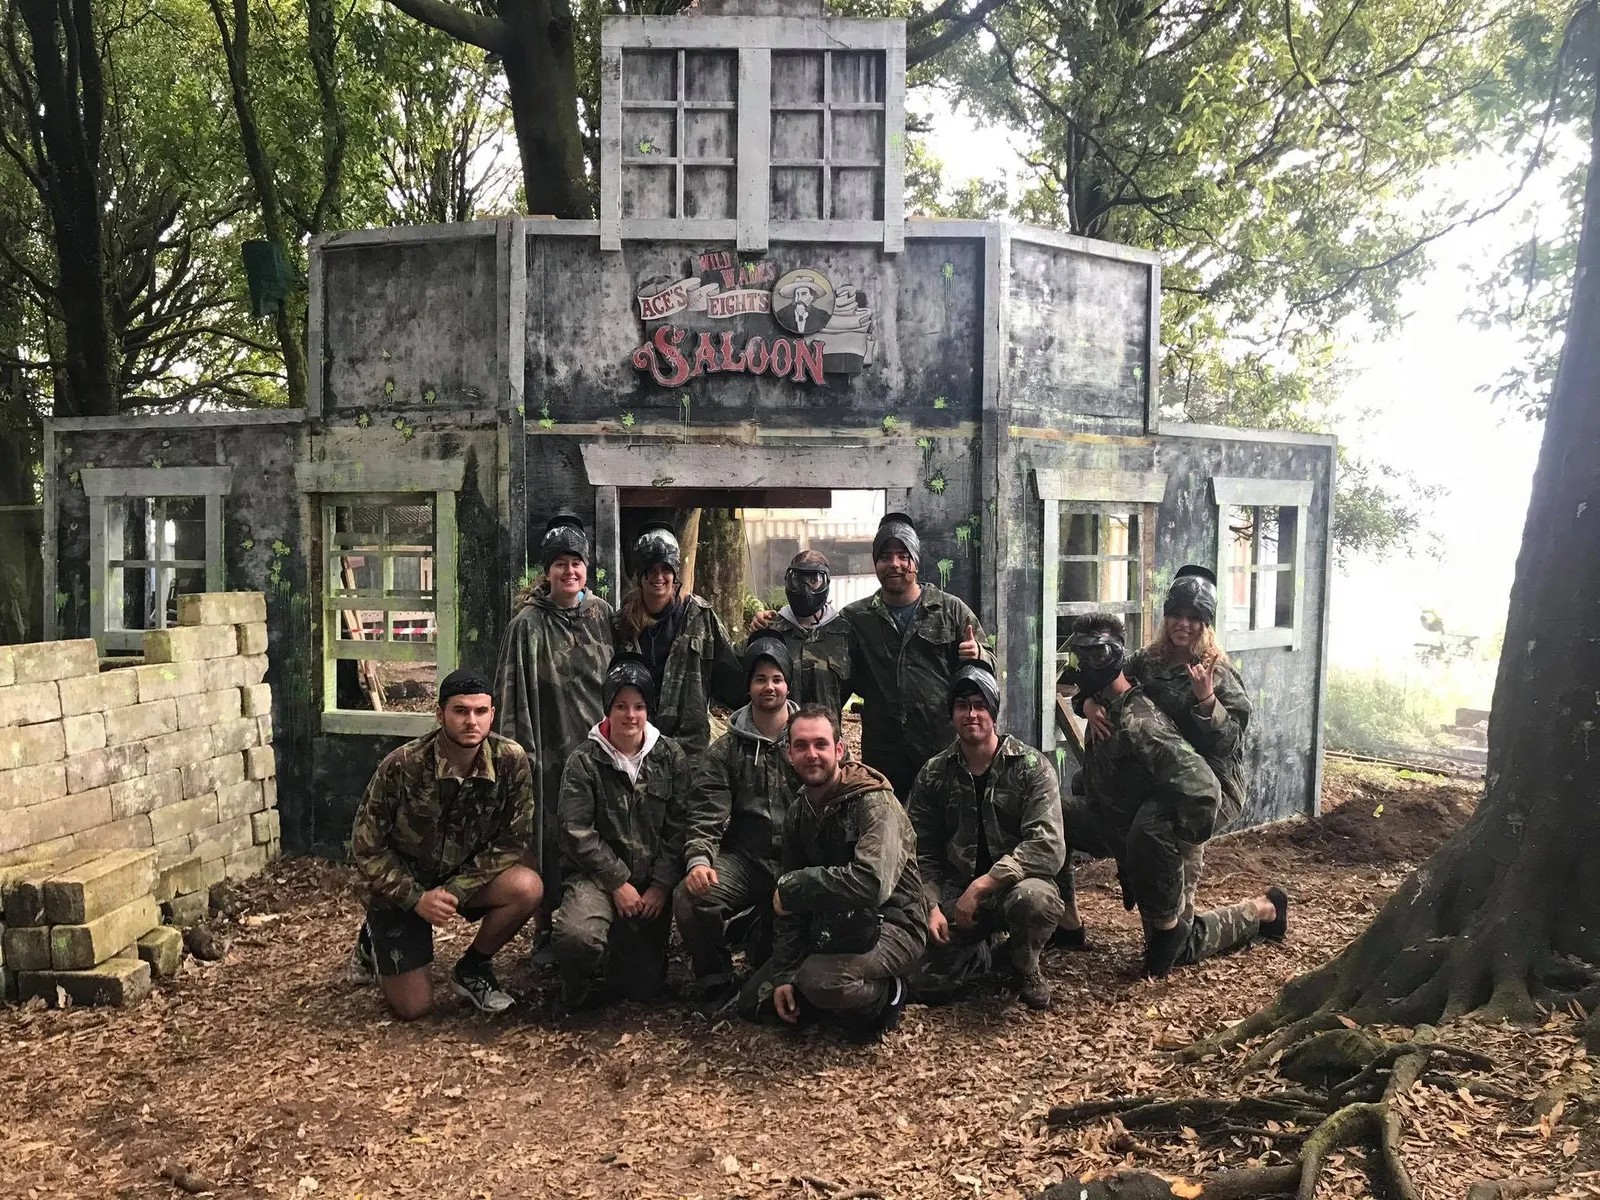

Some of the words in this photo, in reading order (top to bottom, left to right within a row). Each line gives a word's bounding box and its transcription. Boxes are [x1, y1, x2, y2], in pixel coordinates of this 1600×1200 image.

[699, 251, 732, 272] WILD
[641, 285, 688, 318] ACE'S
[709, 292, 770, 316] EIGHT'S
[632, 324, 826, 387] SALOON
